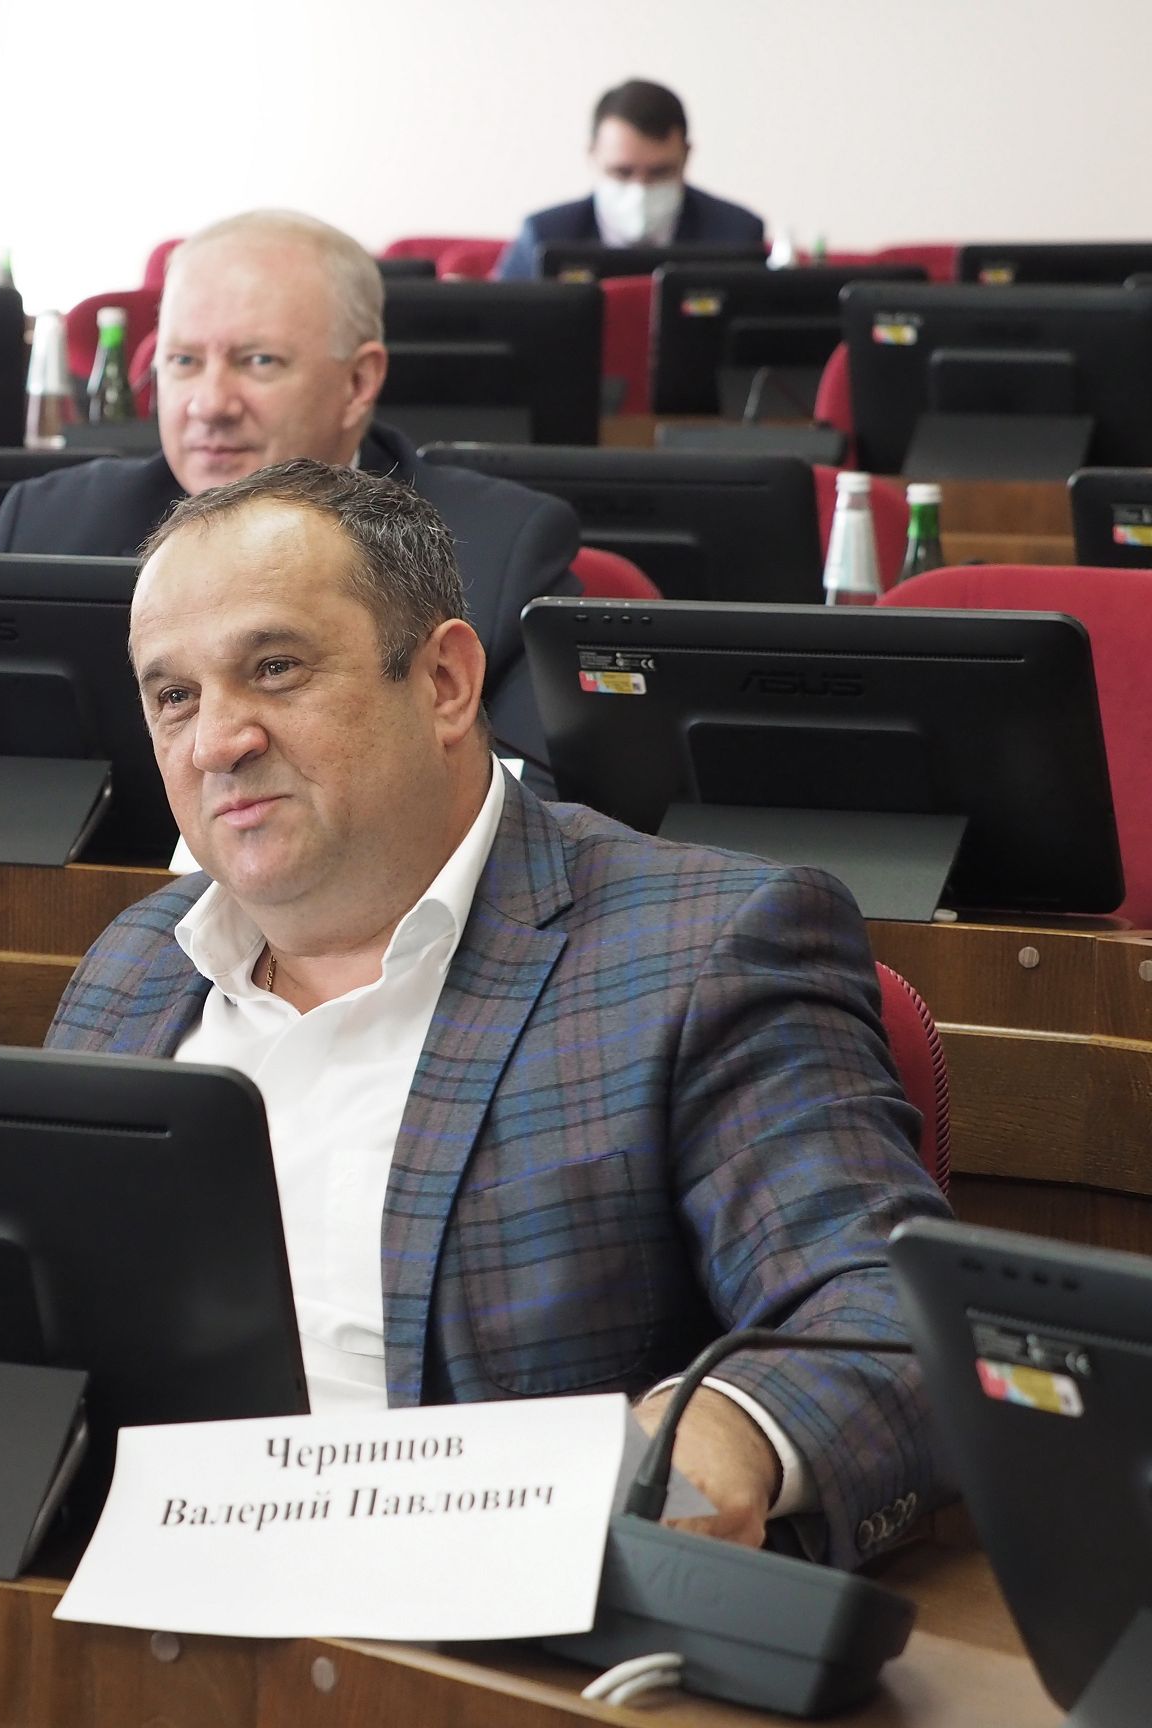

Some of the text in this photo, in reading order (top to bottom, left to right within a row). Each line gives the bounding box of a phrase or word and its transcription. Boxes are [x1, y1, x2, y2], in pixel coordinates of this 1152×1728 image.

[737, 669, 865, 697] ASUS
[266, 1436, 464, 1475] Черницов
[161, 1486, 553, 1531] Валерий Павлович
